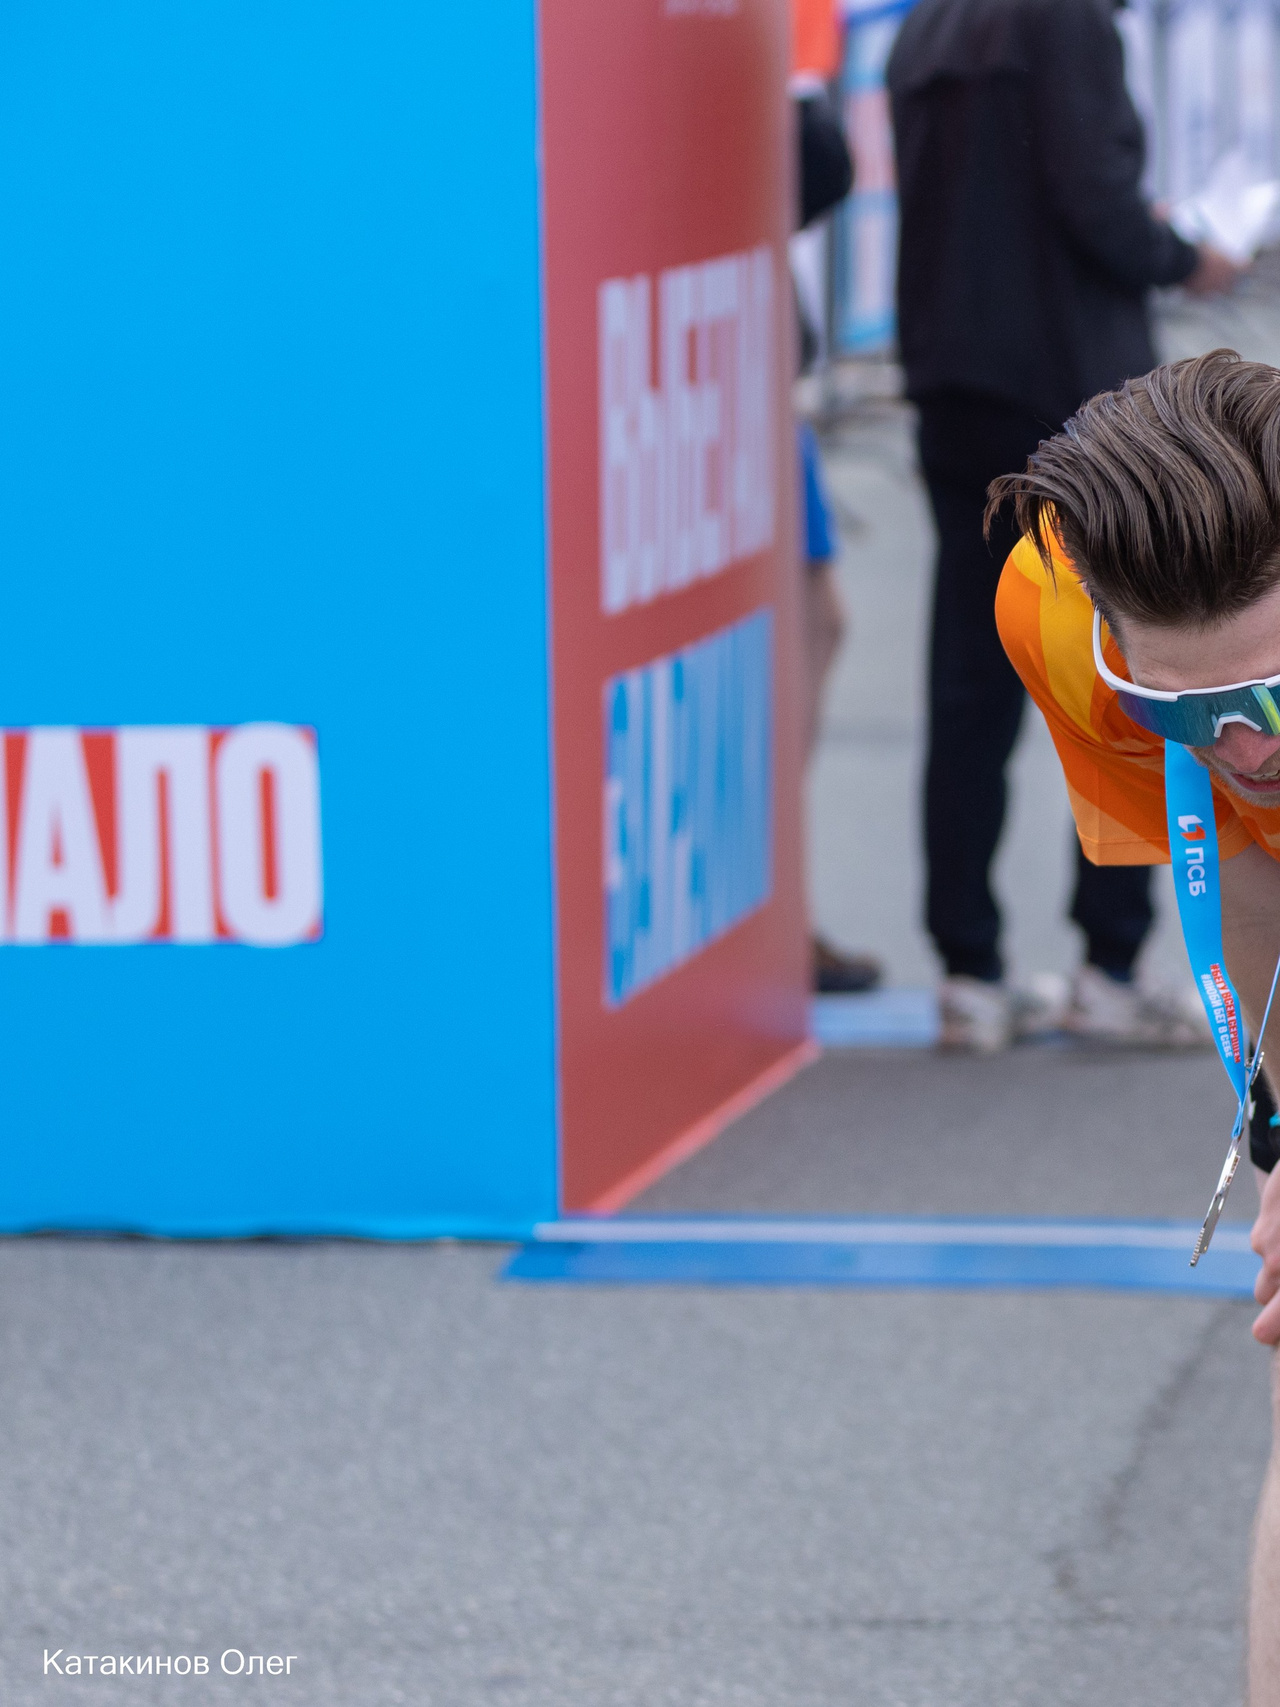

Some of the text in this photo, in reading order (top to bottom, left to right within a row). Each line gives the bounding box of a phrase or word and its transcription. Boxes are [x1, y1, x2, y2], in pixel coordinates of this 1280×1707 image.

[0, 721, 322, 948] АЛО
[1185, 847, 1206, 897] ПСБ
[1201, 973, 1232, 1058] #ЛЮБИ БЕГ В СЕБЕ
[1222, 991, 1235, 1017] ВСЕМ
